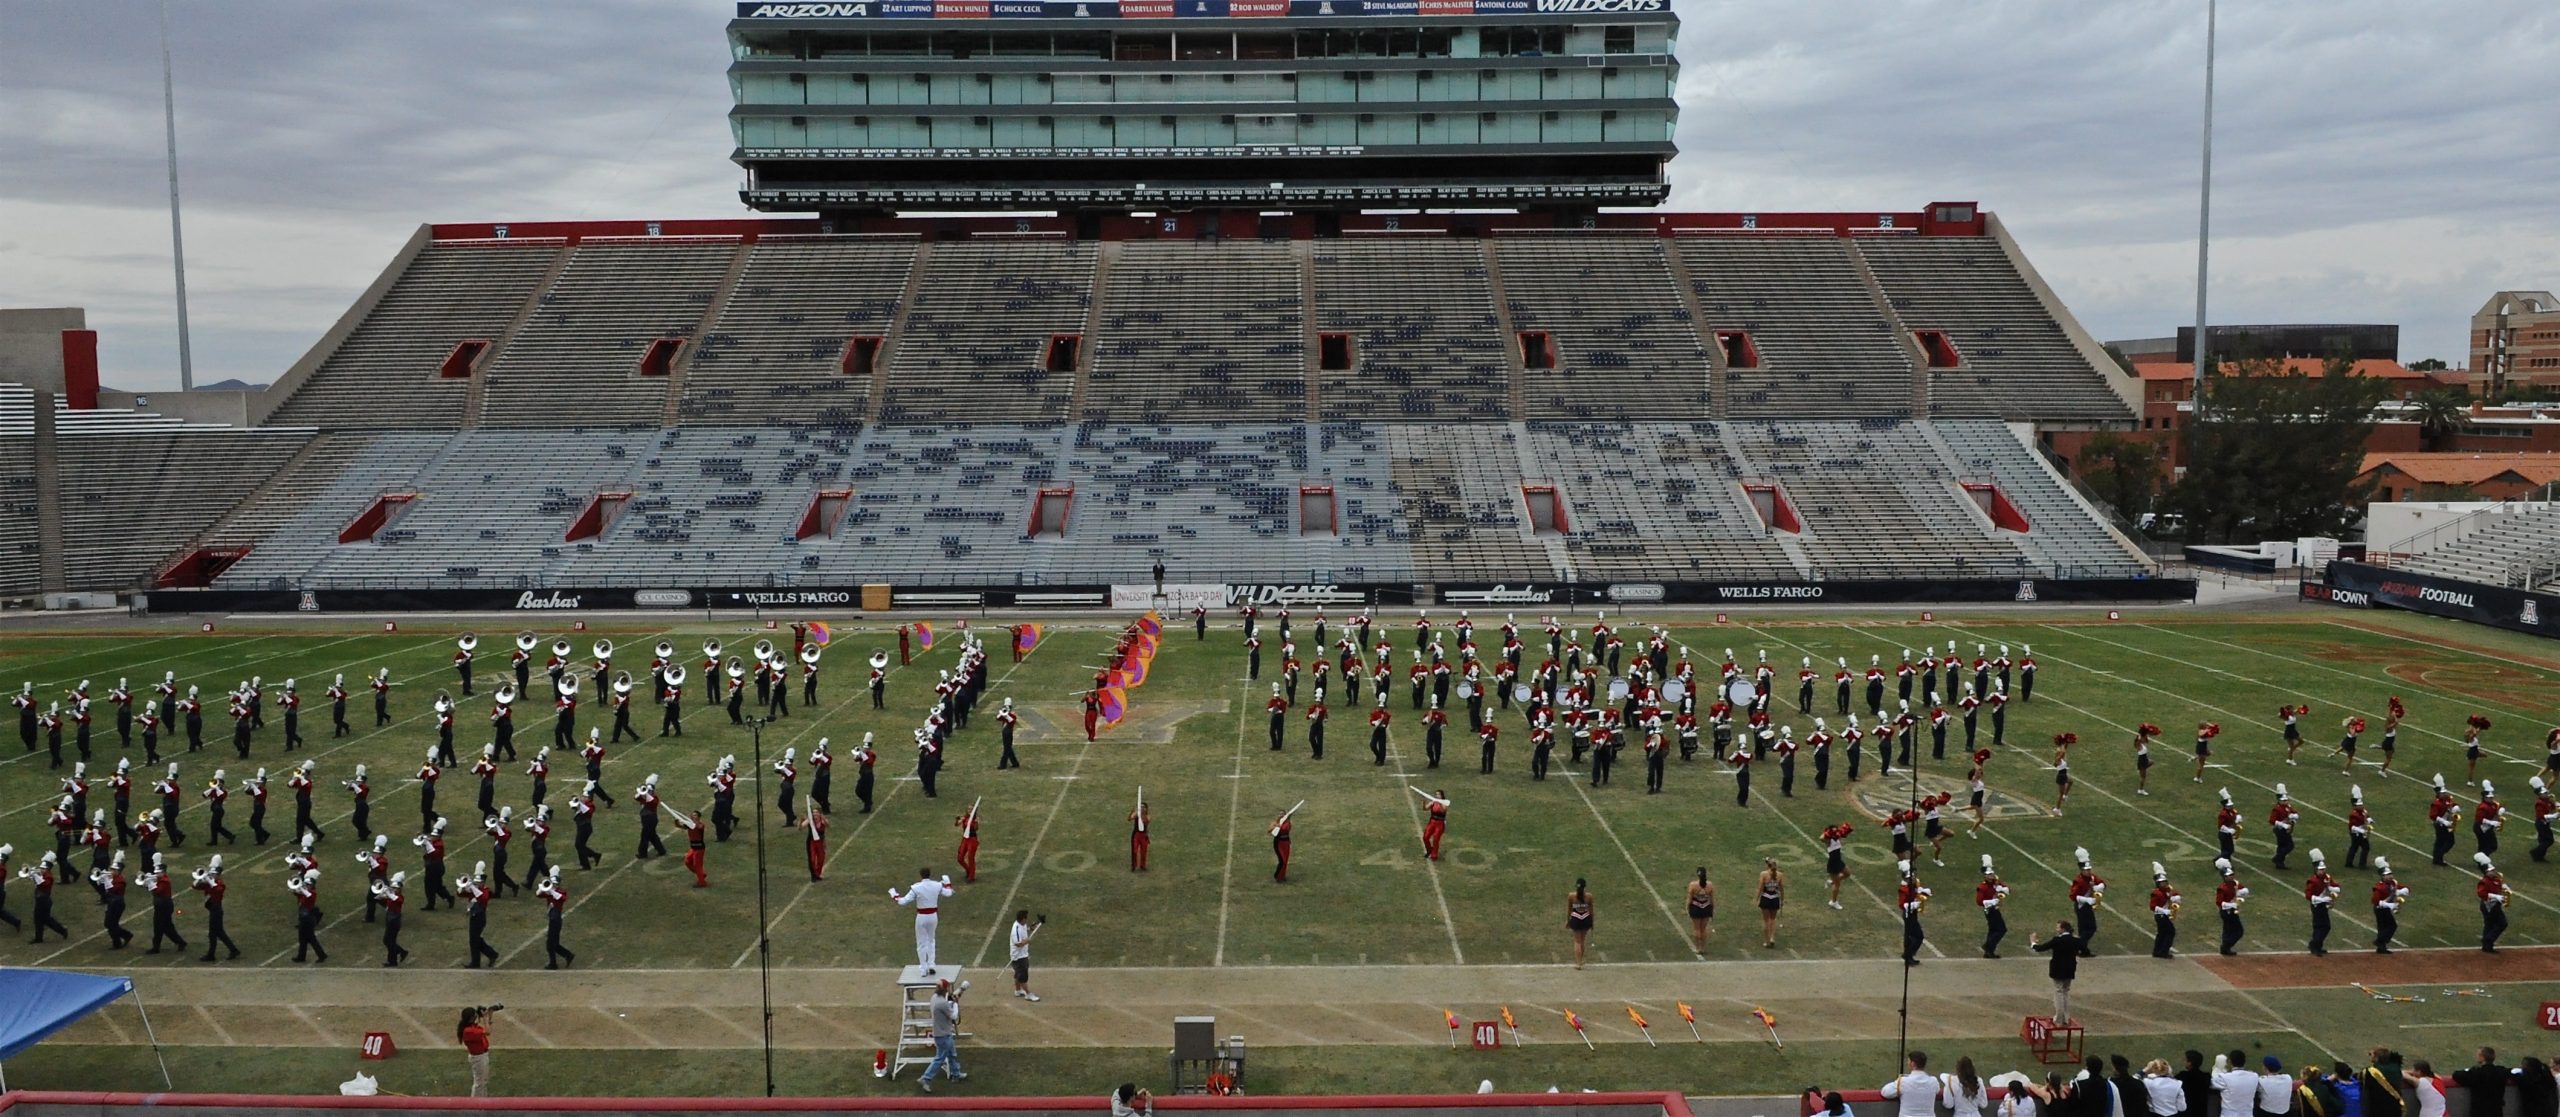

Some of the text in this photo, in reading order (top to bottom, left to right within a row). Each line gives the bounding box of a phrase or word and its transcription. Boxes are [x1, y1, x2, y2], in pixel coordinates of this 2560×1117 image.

[882, 4, 890, 12] 22
[1000, 5, 1023, 13] CHUCK
[1023, 5, 1041, 13] CECIL
[1443, 1, 1474, 9] McALISTER
[1537, 0, 1662, 11] WILDCATS
[751, 4, 867, 17] ARIZONA
[1016, 224, 1029, 232] 20
[1164, 223, 1176, 232] 21
[1387, 221, 1398, 229] 22
[1583, 220, 1595, 229] 23
[1743, 220, 1755, 229] 24
[1880, 220, 1892, 229] 25
[496, 230, 506, 239] 17
[648, 228, 660, 237] 18
[137, 397, 147, 406] 16
[1115, 592, 1148, 601] UNIVERSITY
[1190, 592, 1209, 600] BAND
[1210, 592, 1222, 600] DAY
[1719, 587, 1823, 597] WELLS FARGO
[516, 591, 581, 608] Bashas'
[745, 592, 849, 603] WELLS FARGO
[1476, 1026, 1496, 1045] 40
[364, 1036, 383, 1056] 40
